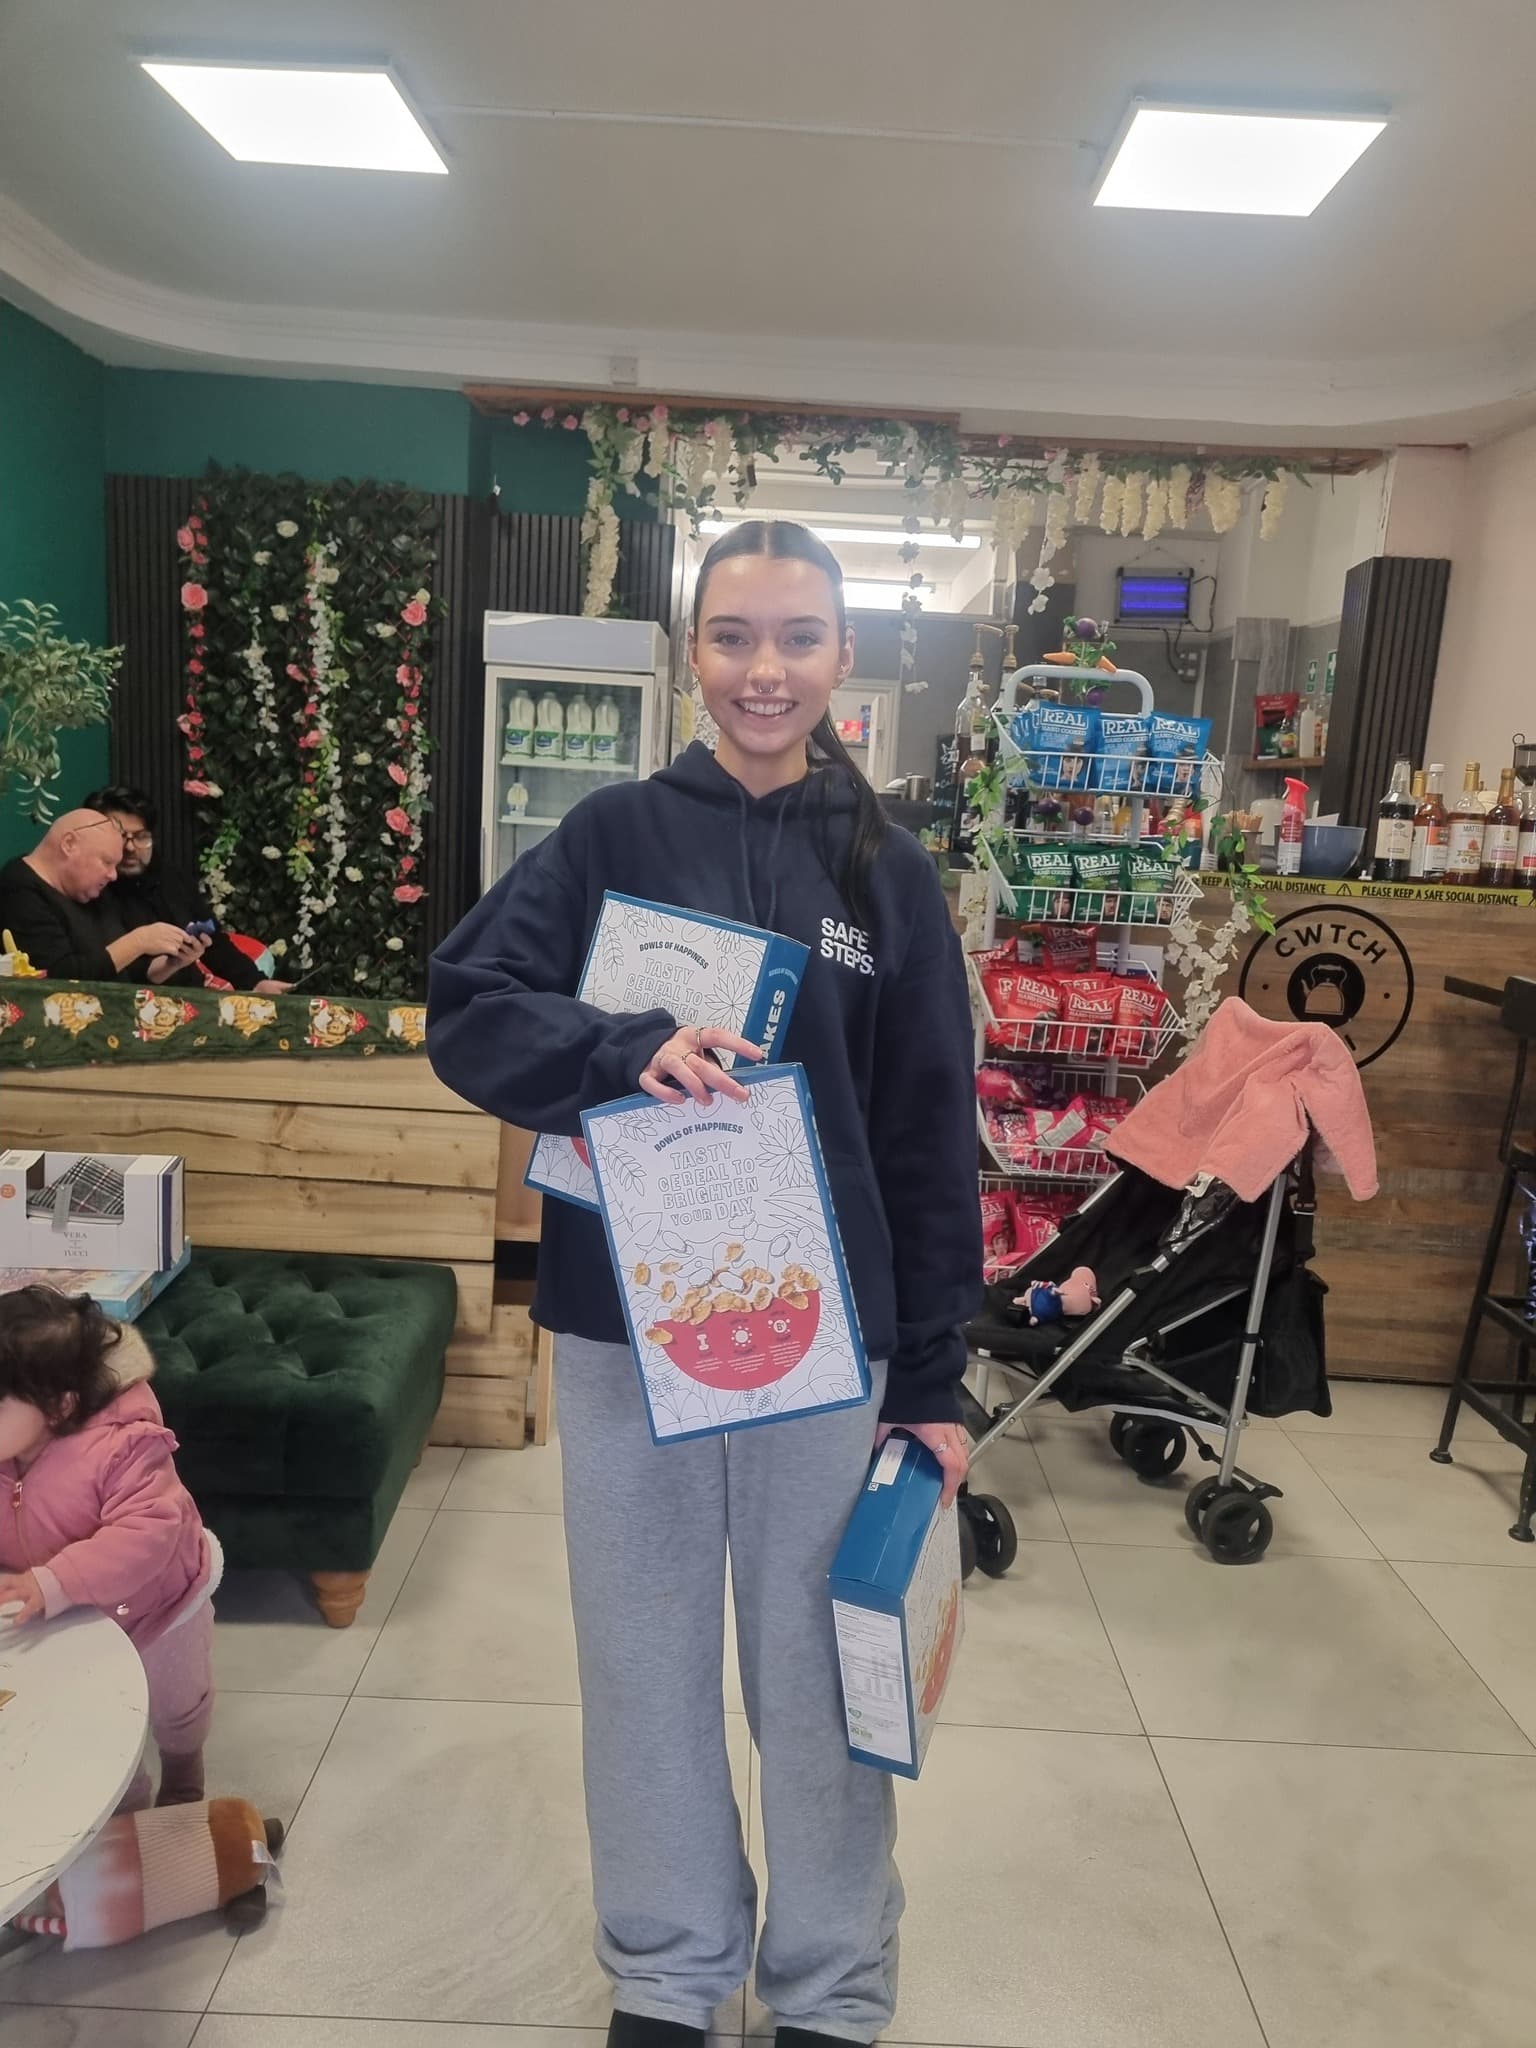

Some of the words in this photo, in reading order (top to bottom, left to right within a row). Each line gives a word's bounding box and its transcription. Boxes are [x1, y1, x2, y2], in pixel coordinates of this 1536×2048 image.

[1043, 711, 1086, 727] REAL
[1106, 720, 1146, 734] REAL
[1156, 717, 1197, 735] REAL
[1031, 854, 1073, 867] REAL
[1078, 854, 1120, 870] REAL
[1132, 861, 1172, 873] REAL
[1202, 876, 1222, 887] KEEP
[1223, 878, 1230, 887] A
[1285, 882, 1326, 895] DISTANCE
[1361, 886, 1395, 898] PLEASE
[1394, 888, 1414, 899] KEEP
[1415, 889, 1422, 899] A
[1424, 890, 1444, 900] SAFE
[1446, 891, 1476, 903] SOCIAL
[1477, 893, 1519, 906] DISTANCE
[821, 917, 870, 951] SAFE
[1275, 923, 1387, 964] CWTCH
[639, 941, 663, 952] BOWLS
[664, 941, 673, 950] OF
[673, 943, 710, 969] HAPPINESS
[645, 957, 694, 985] TASTY
[627, 973, 681, 1002] CEREAL
[686, 988, 703, 1006] TO
[1021, 978, 1058, 1001] REAL
[1122, 988, 1155, 1008] REAL
[1072, 997, 1112, 1012] REAL
[654, 1130, 682, 1152] BOWLS
[683, 1125, 693, 1136] OF
[694, 1122, 744, 1135] HAPPINESS
[670, 1141, 732, 1170] TASTY
[658, 1163, 729, 1192] CEREAL
[732, 1158, 755, 1175] TO
[663, 1176, 759, 1209] BRIGHTEN
[671, 1209, 712, 1226] YOUR
[715, 1196, 752, 1220] DAY
[981, 1202, 1006, 1215] EAL
